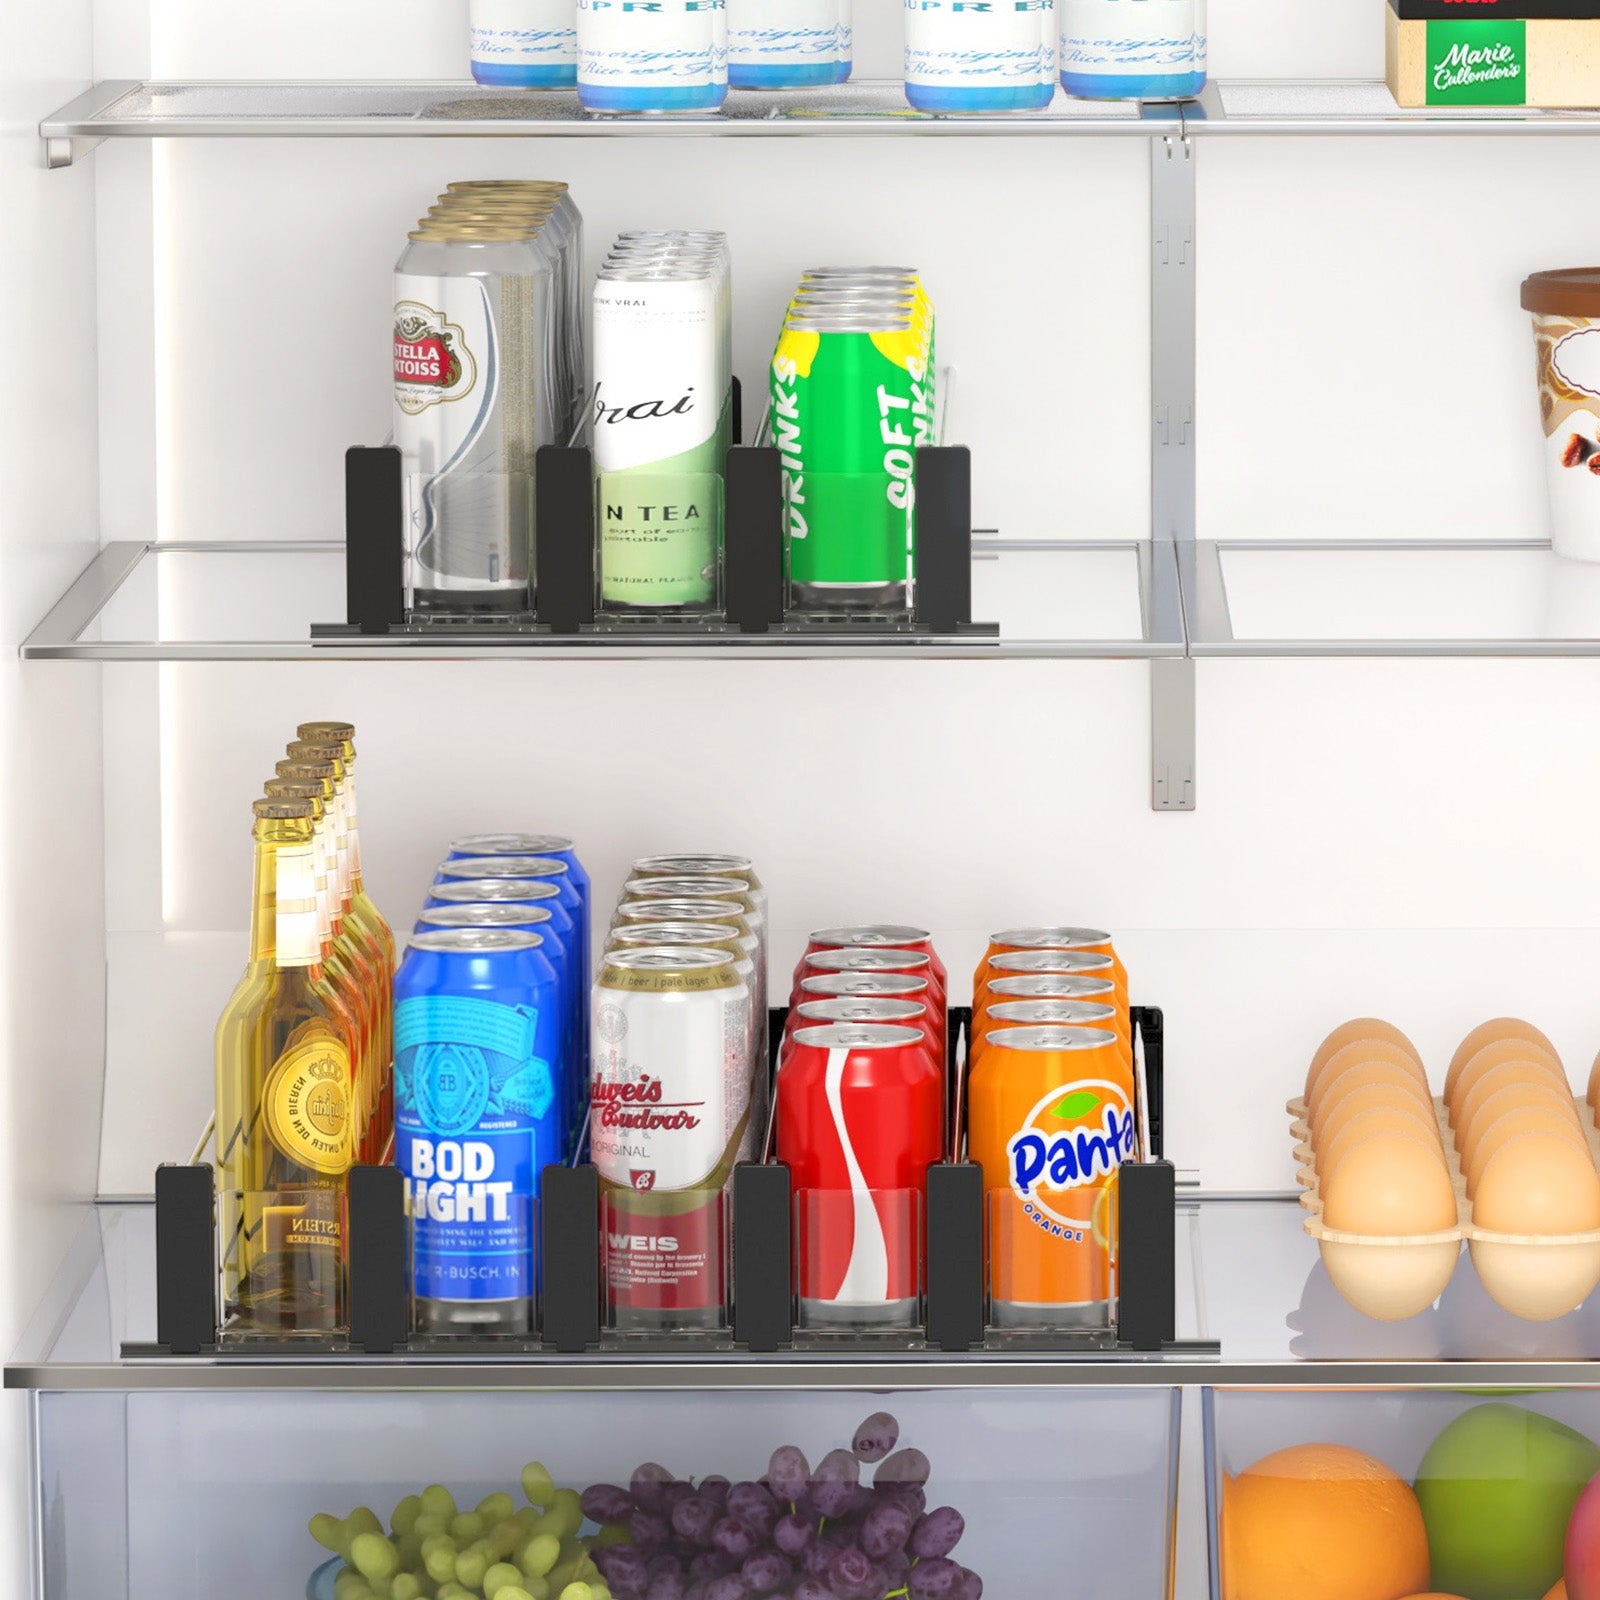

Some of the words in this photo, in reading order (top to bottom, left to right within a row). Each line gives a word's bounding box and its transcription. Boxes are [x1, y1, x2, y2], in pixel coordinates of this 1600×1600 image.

[876, 384, 918, 510] SOFT
[637, 504, 700, 521] TEA
[660, 977, 683, 988] pale
[411, 1138, 496, 1182] BOD
[1023, 1203, 1083, 1243] ORANGE
